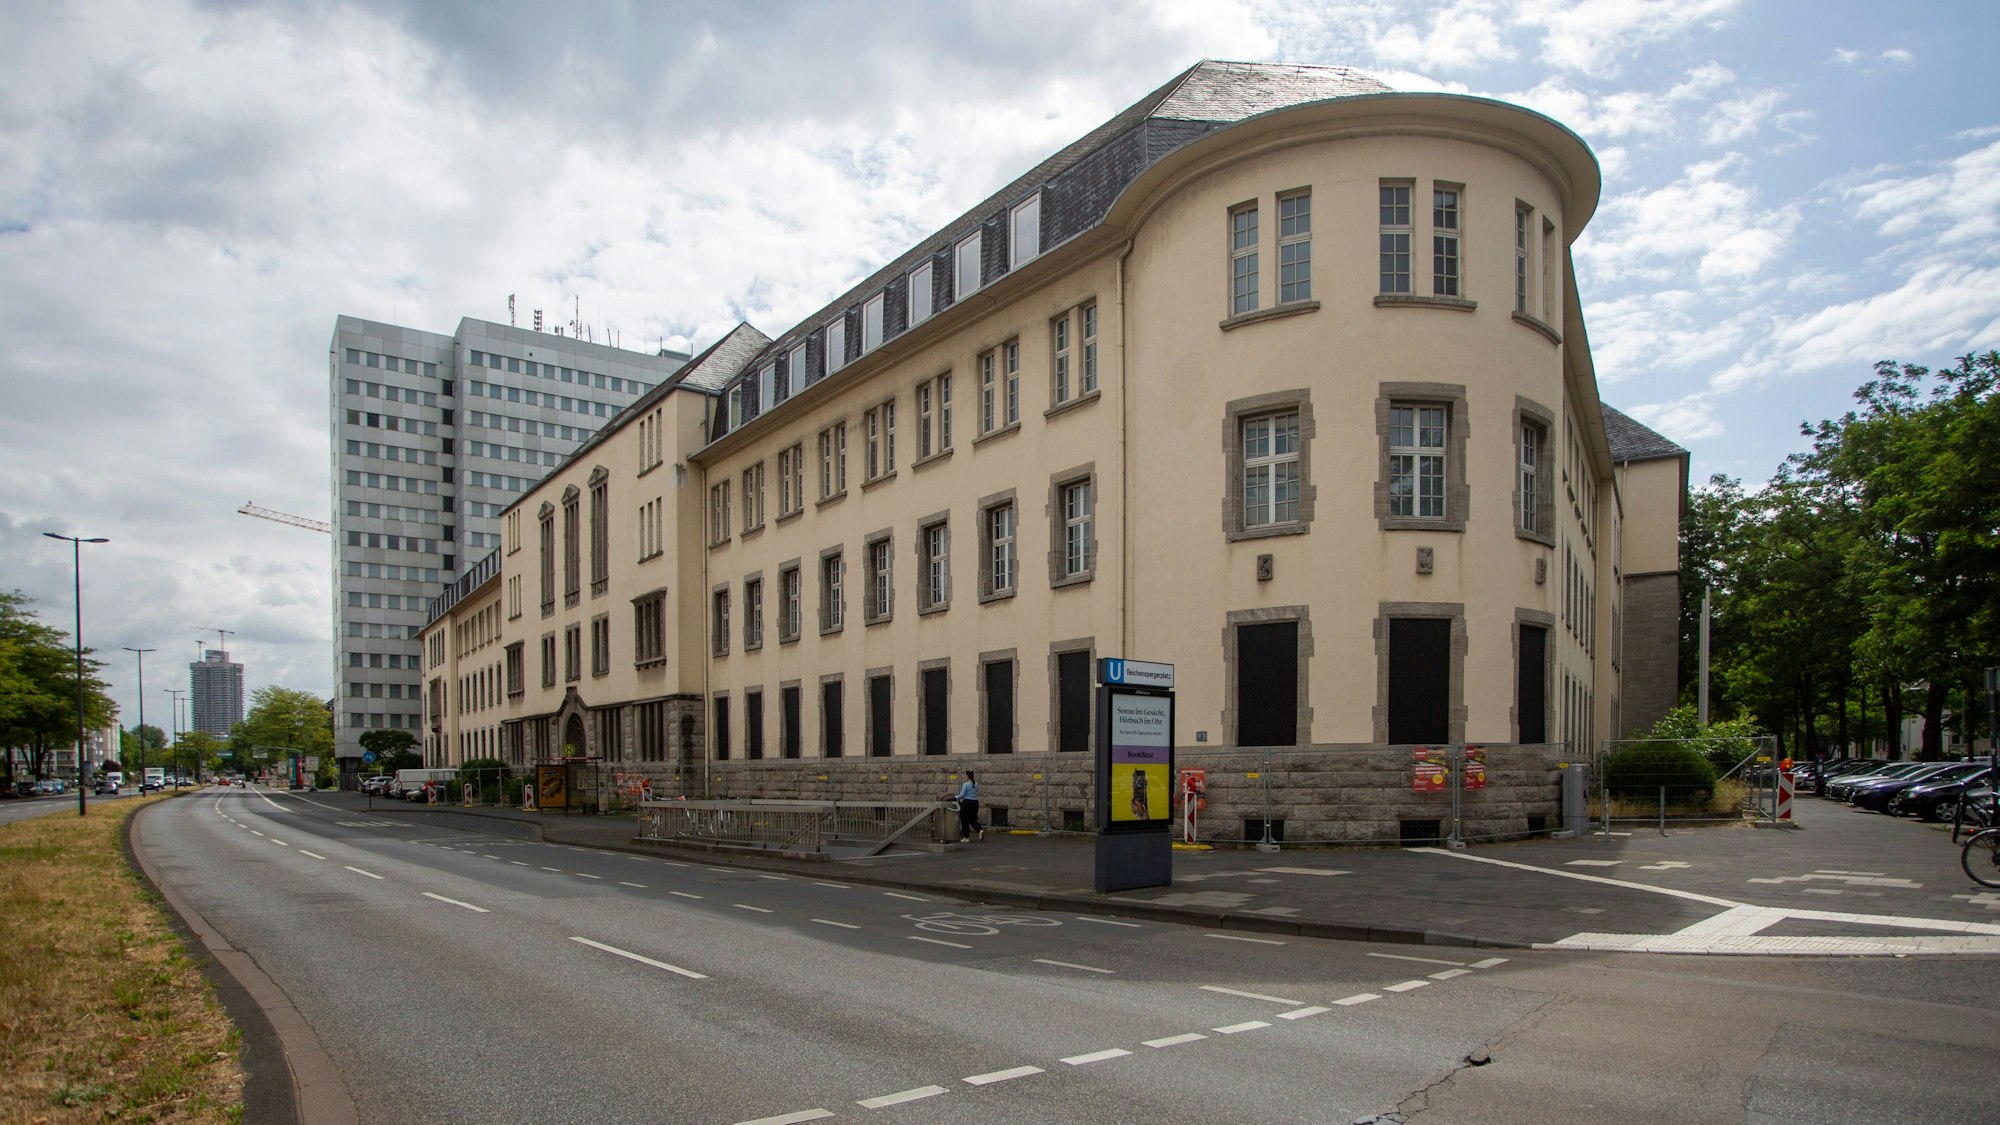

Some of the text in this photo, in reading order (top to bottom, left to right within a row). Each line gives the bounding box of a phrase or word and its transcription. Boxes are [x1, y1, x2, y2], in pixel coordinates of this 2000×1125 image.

[1110, 661, 1172, 680] U Reichenspergerplatz
[1144, 708, 1165, 717] Gesicht,
[1120, 716, 1143, 724] Hörbuch
